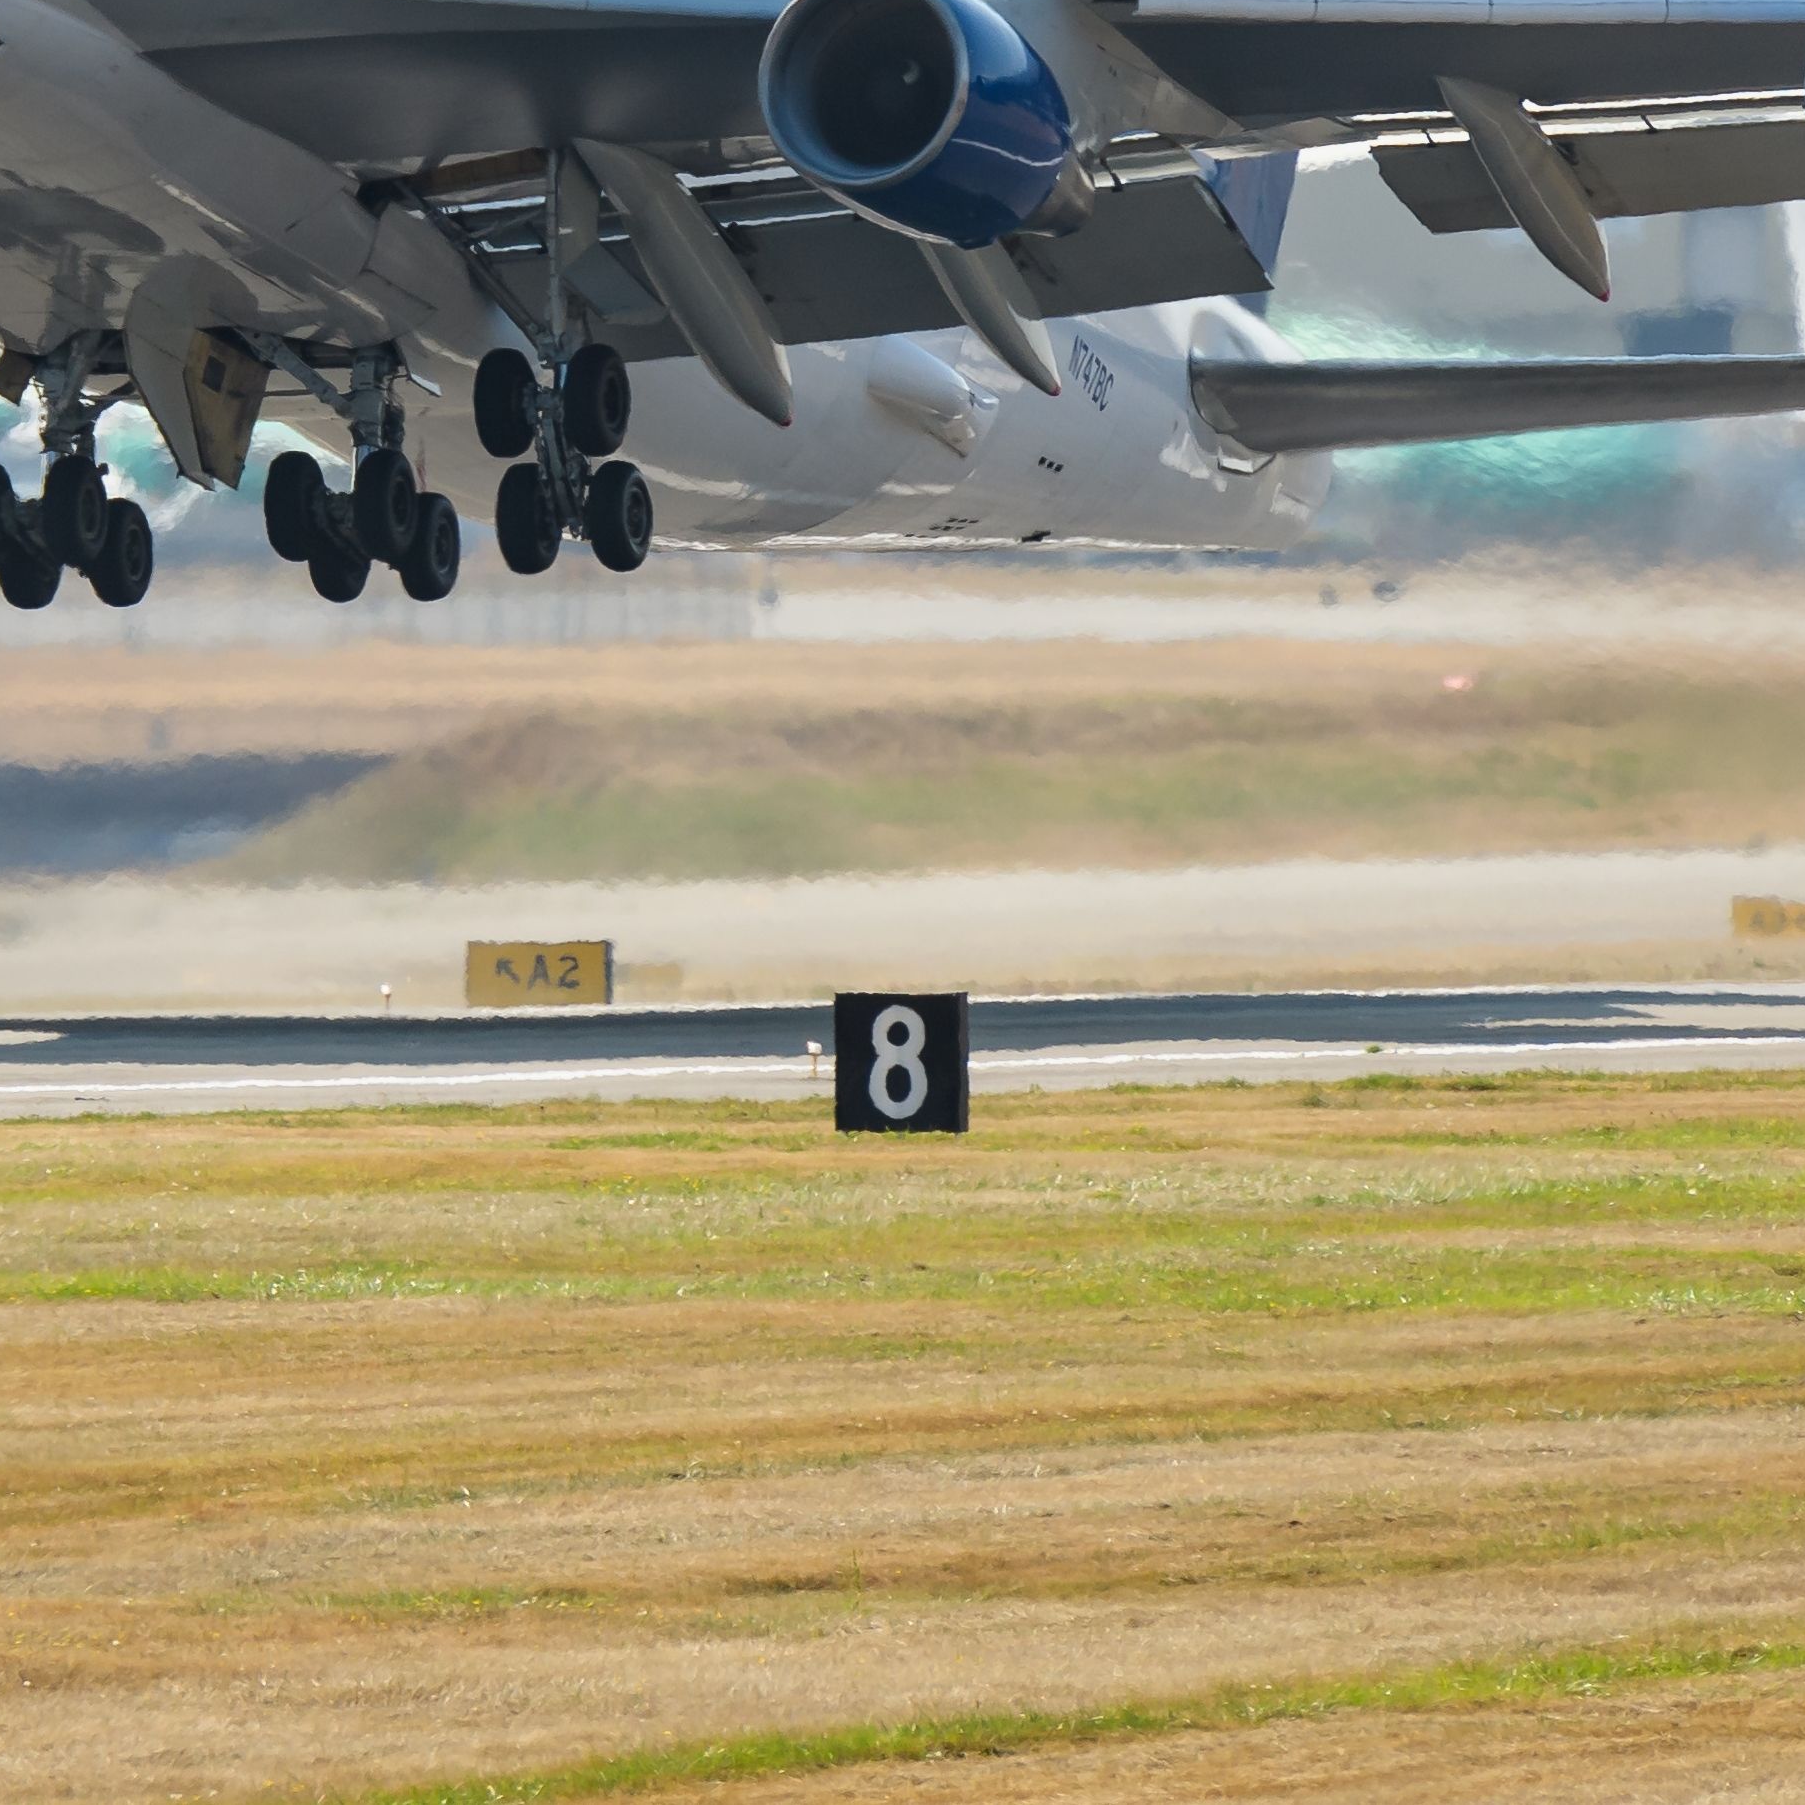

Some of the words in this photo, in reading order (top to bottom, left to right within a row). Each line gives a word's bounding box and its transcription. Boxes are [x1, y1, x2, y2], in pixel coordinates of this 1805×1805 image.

[1068, 334, 1114, 412] N747BC
[527, 953, 580, 991] A2
[868, 1005, 928, 1120] 8
